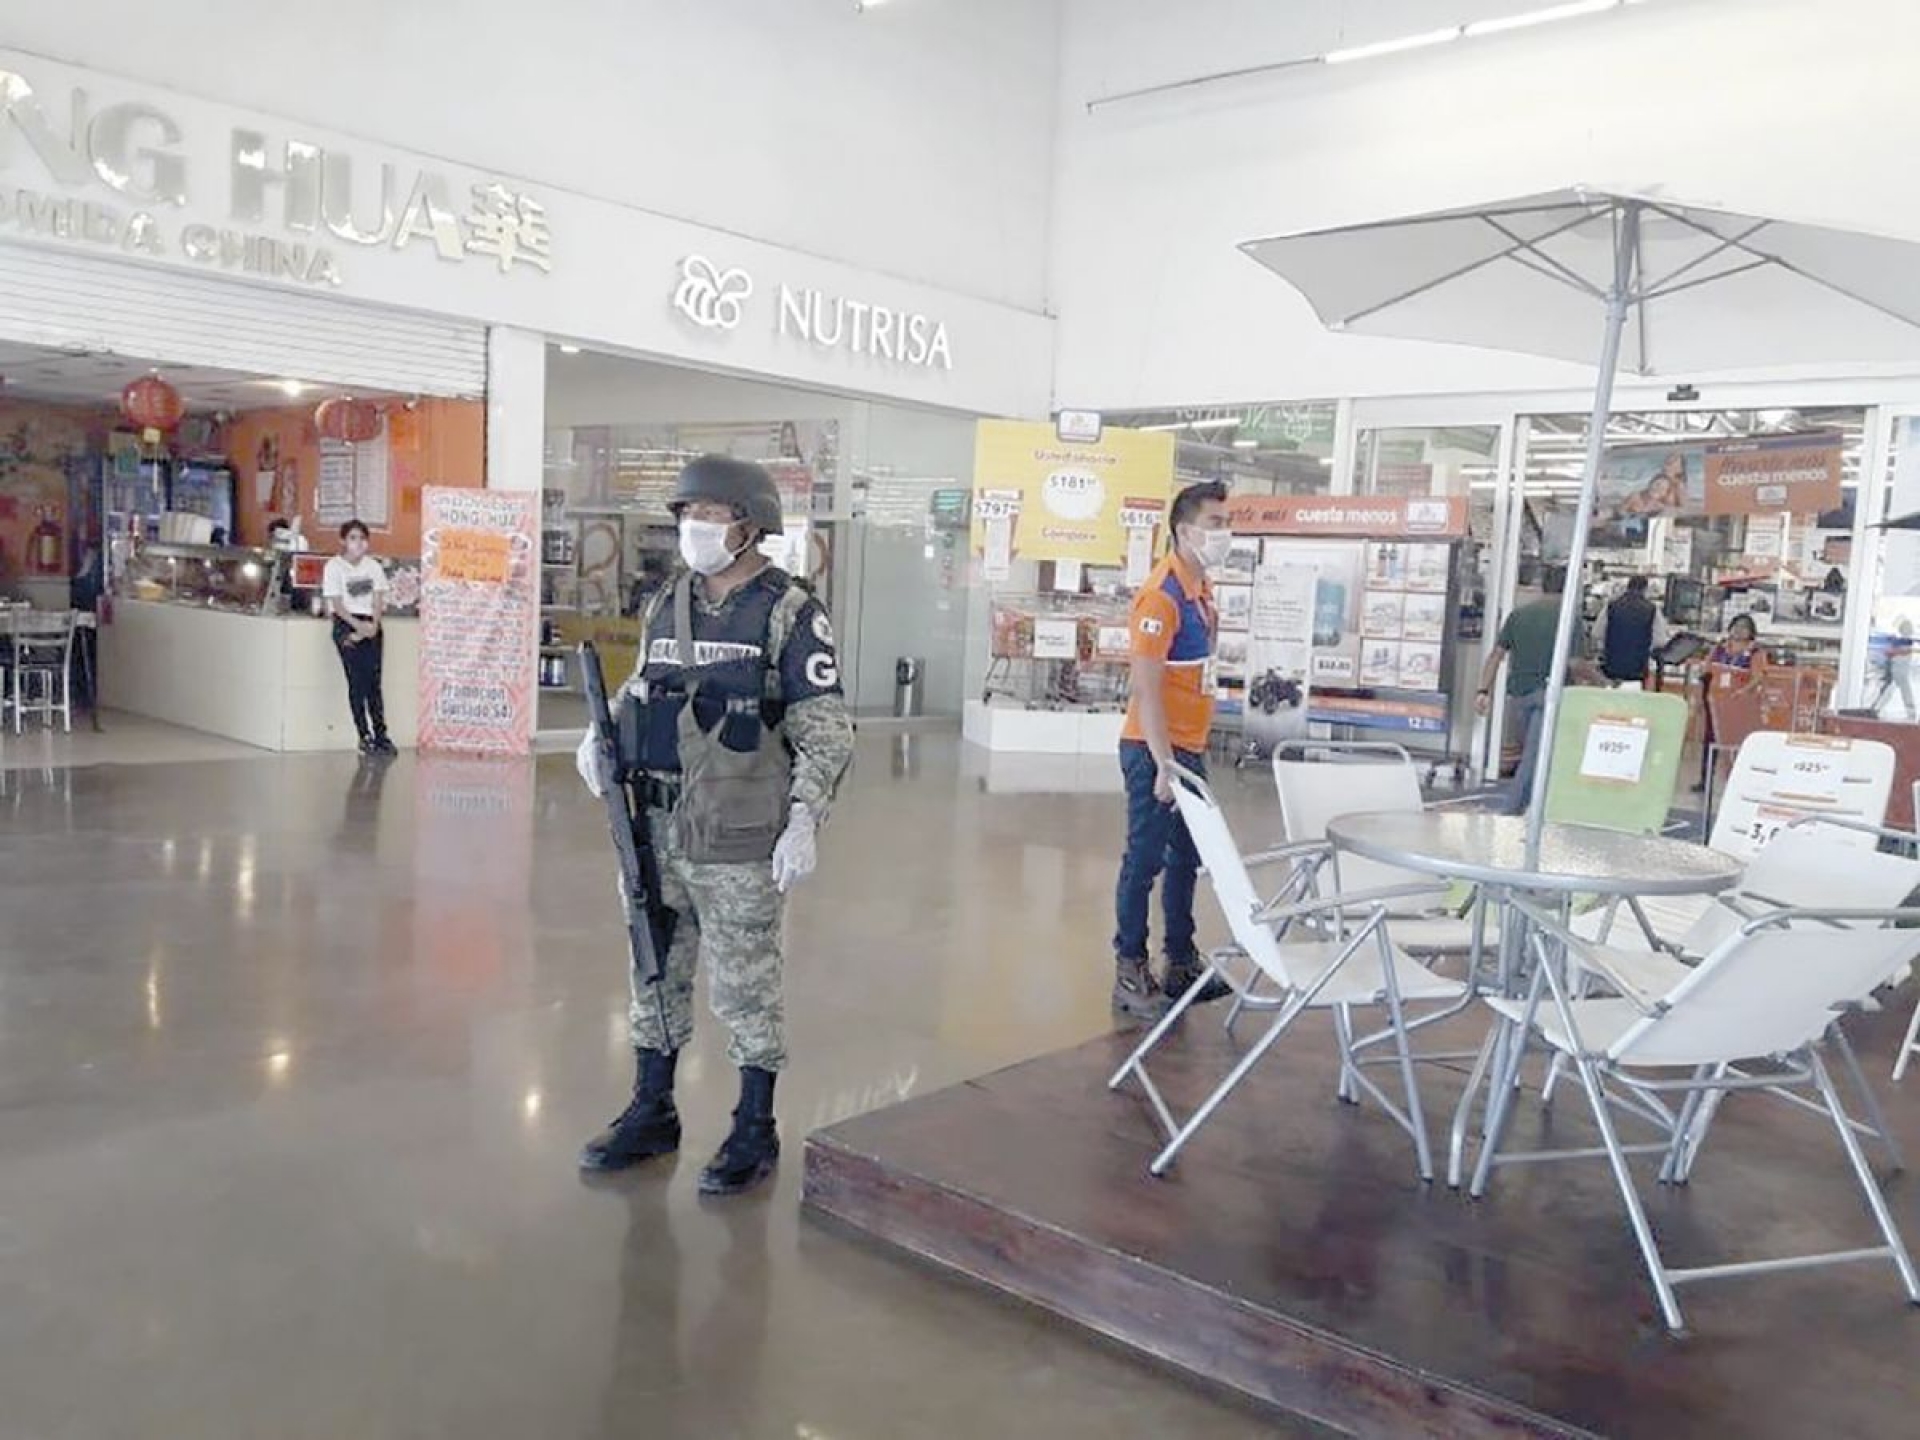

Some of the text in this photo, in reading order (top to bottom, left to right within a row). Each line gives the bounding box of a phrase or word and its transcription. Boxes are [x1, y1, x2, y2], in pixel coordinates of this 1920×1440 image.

[231, 128, 464, 261] HUA
[180, 223, 342, 286] CHINA
[778, 281, 953, 370] NUTRISA
[1295, 505, 1344, 522] cuesta
[1345, 508, 1398, 524] menos
[805, 652, 837, 687] G
